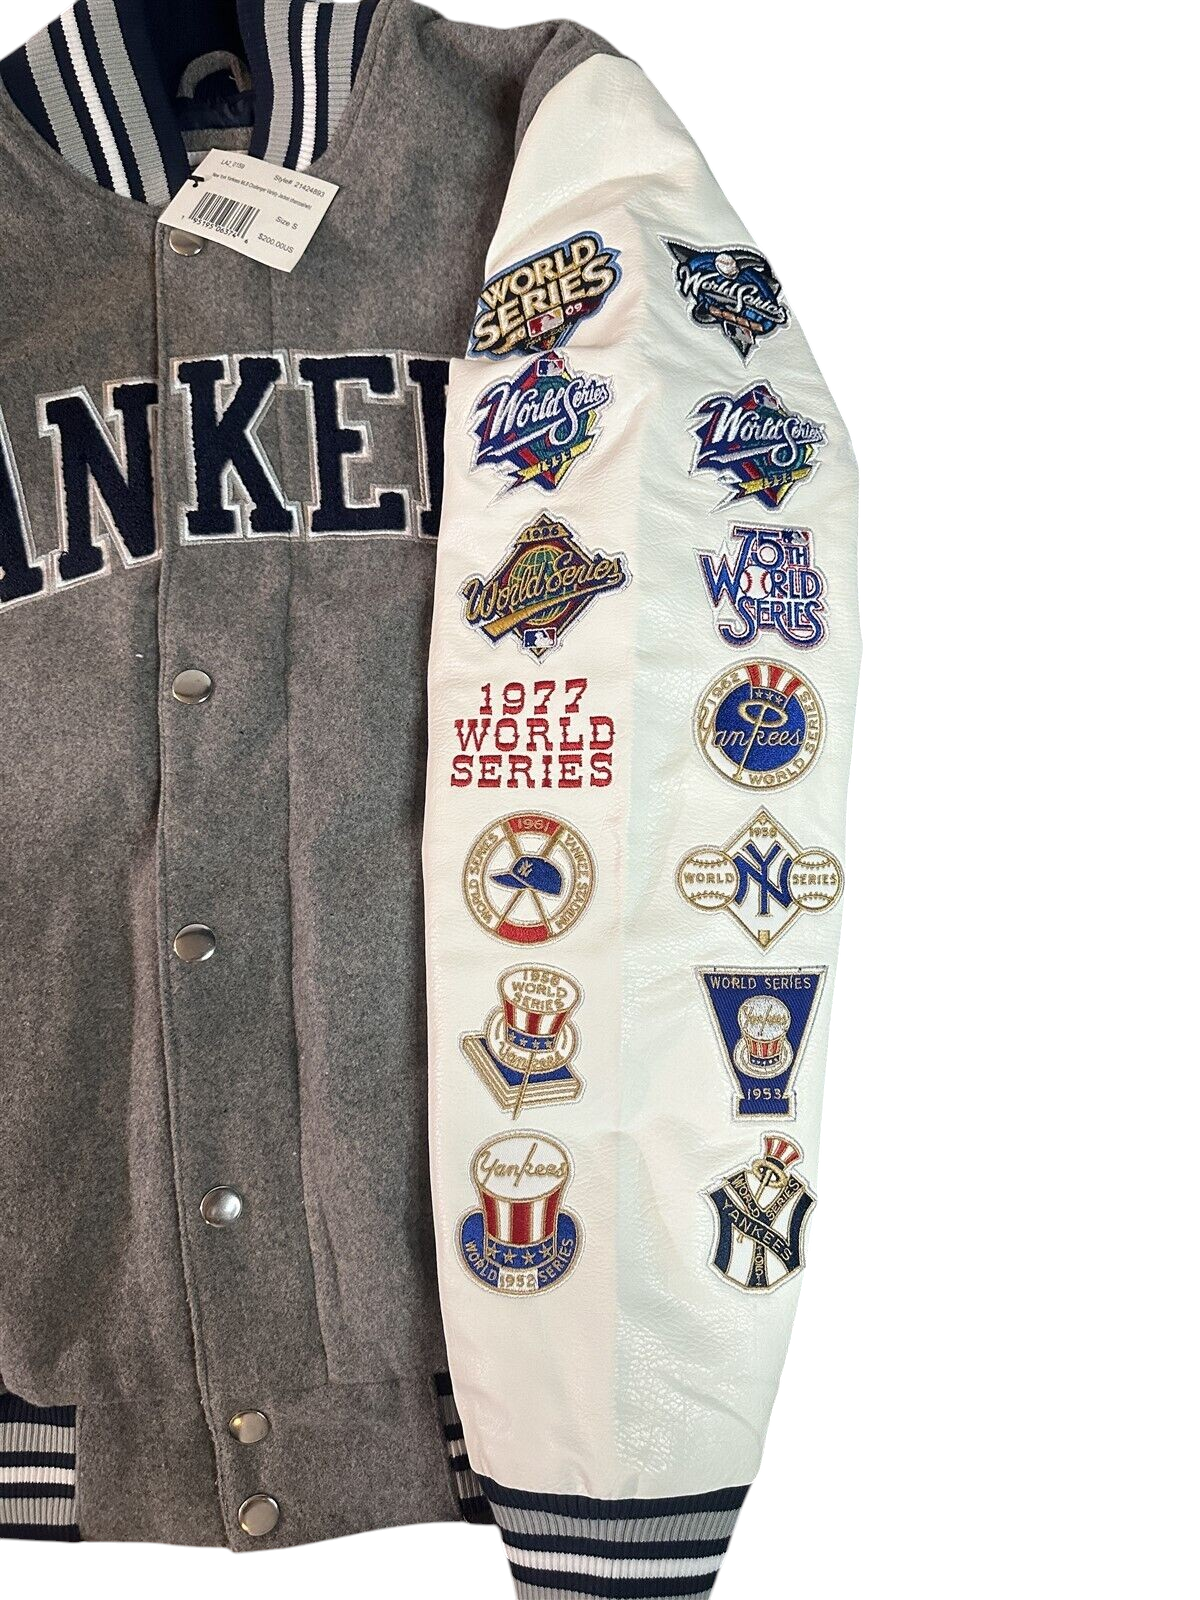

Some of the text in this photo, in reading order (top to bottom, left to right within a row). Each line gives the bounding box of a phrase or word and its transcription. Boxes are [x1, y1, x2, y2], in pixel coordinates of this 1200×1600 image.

[274, 174, 326, 198] Style# 21424893
[192, 216, 215, 230] 95195
[215, 225, 237, 238] 06374
[276, 215, 291, 227] Size
[258, 233, 295, 254] $200.00US
[480, 238, 597, 310] WORLD
[680, 265, 787, 319] World Series
[473, 255, 616, 351] SERIES
[565, 303, 582, 316] 09
[487, 377, 611, 445] World Series
[708, 400, 826, 467] World Series
[526, 525, 560, 540] 1996
[462, 551, 624, 622] World Series
[719, 597, 825, 646] SERIES
[480, 678, 588, 715] 1977
[707, 672, 741, 706] 1962
[454, 716, 616, 751] WORLD
[748, 689, 820, 785] WORLD SERIES
[450, 752, 613, 788] SERIES
[517, 819, 551, 832] 1961
[468, 833, 499, 924] WORLD SERIES
[554, 832, 590, 930] YANKEE STADIUM
[684, 872, 735, 884] WORLD
[732, 840, 794, 916] NY
[792, 873, 838, 885] SERIES
[511, 981, 567, 998] WORLD
[513, 991, 564, 1011] SERIES
[710, 975, 811, 991] WORLD SERIES
[747, 1087, 783, 1100] 1953
[480, 1142, 567, 1187] Yankees
[731, 1174, 760, 1218] WORLD
[765, 1178, 799, 1221] SERIES
[722, 1198, 793, 1261] YANKEES
[465, 1238, 574, 1288] WORLD 1952 SERIES
